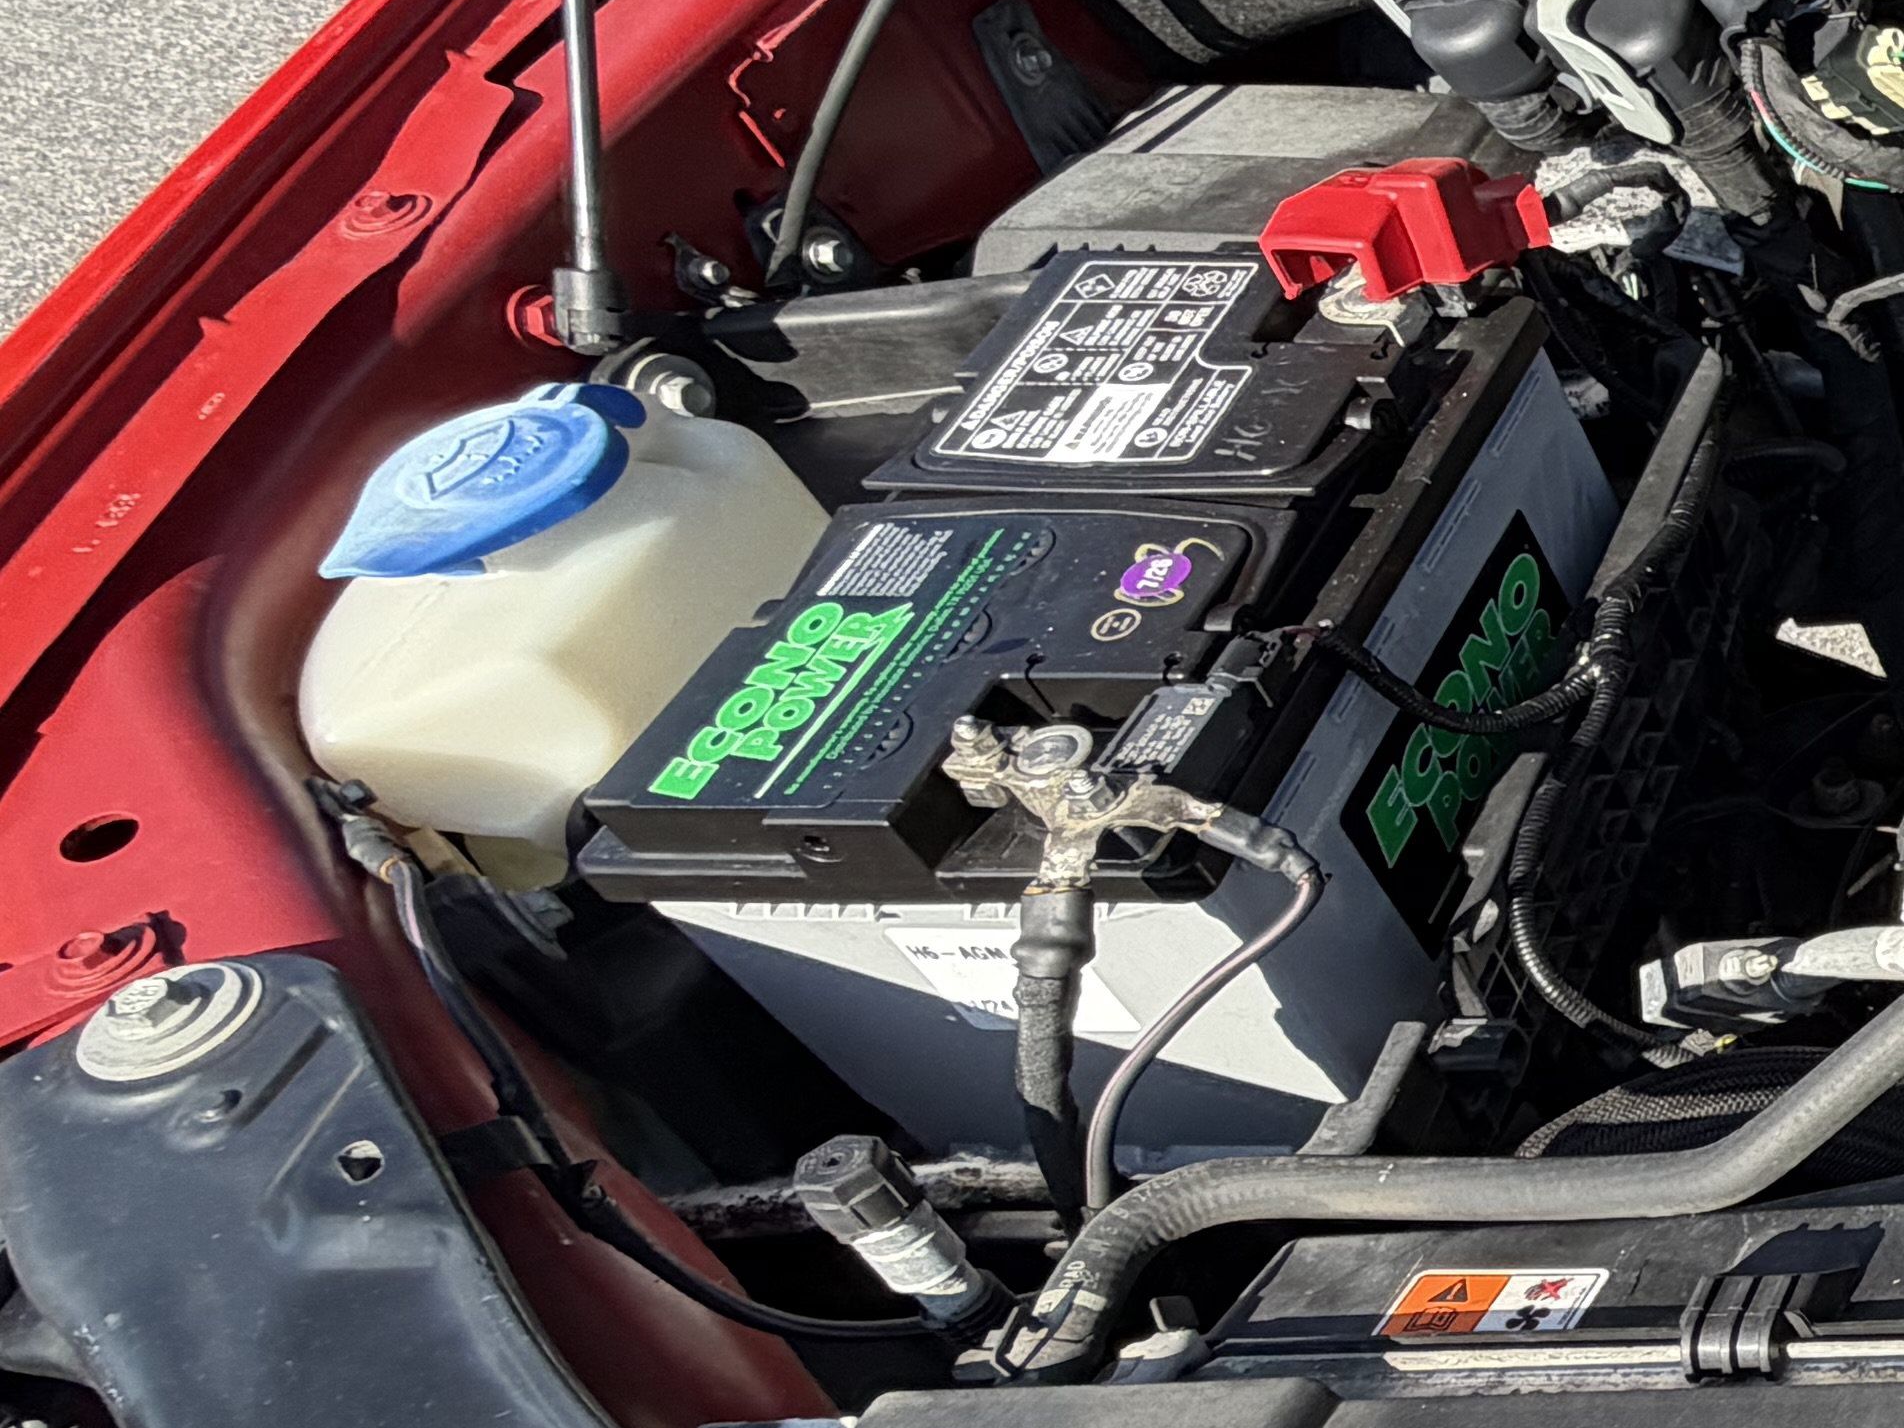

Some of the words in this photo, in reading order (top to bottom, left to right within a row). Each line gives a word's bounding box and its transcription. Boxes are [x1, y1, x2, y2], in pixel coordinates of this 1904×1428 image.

[648, 602, 844, 800] ECONO
[743, 606, 904, 762] POWER
[1366, 552, 1541, 869] ECONO
